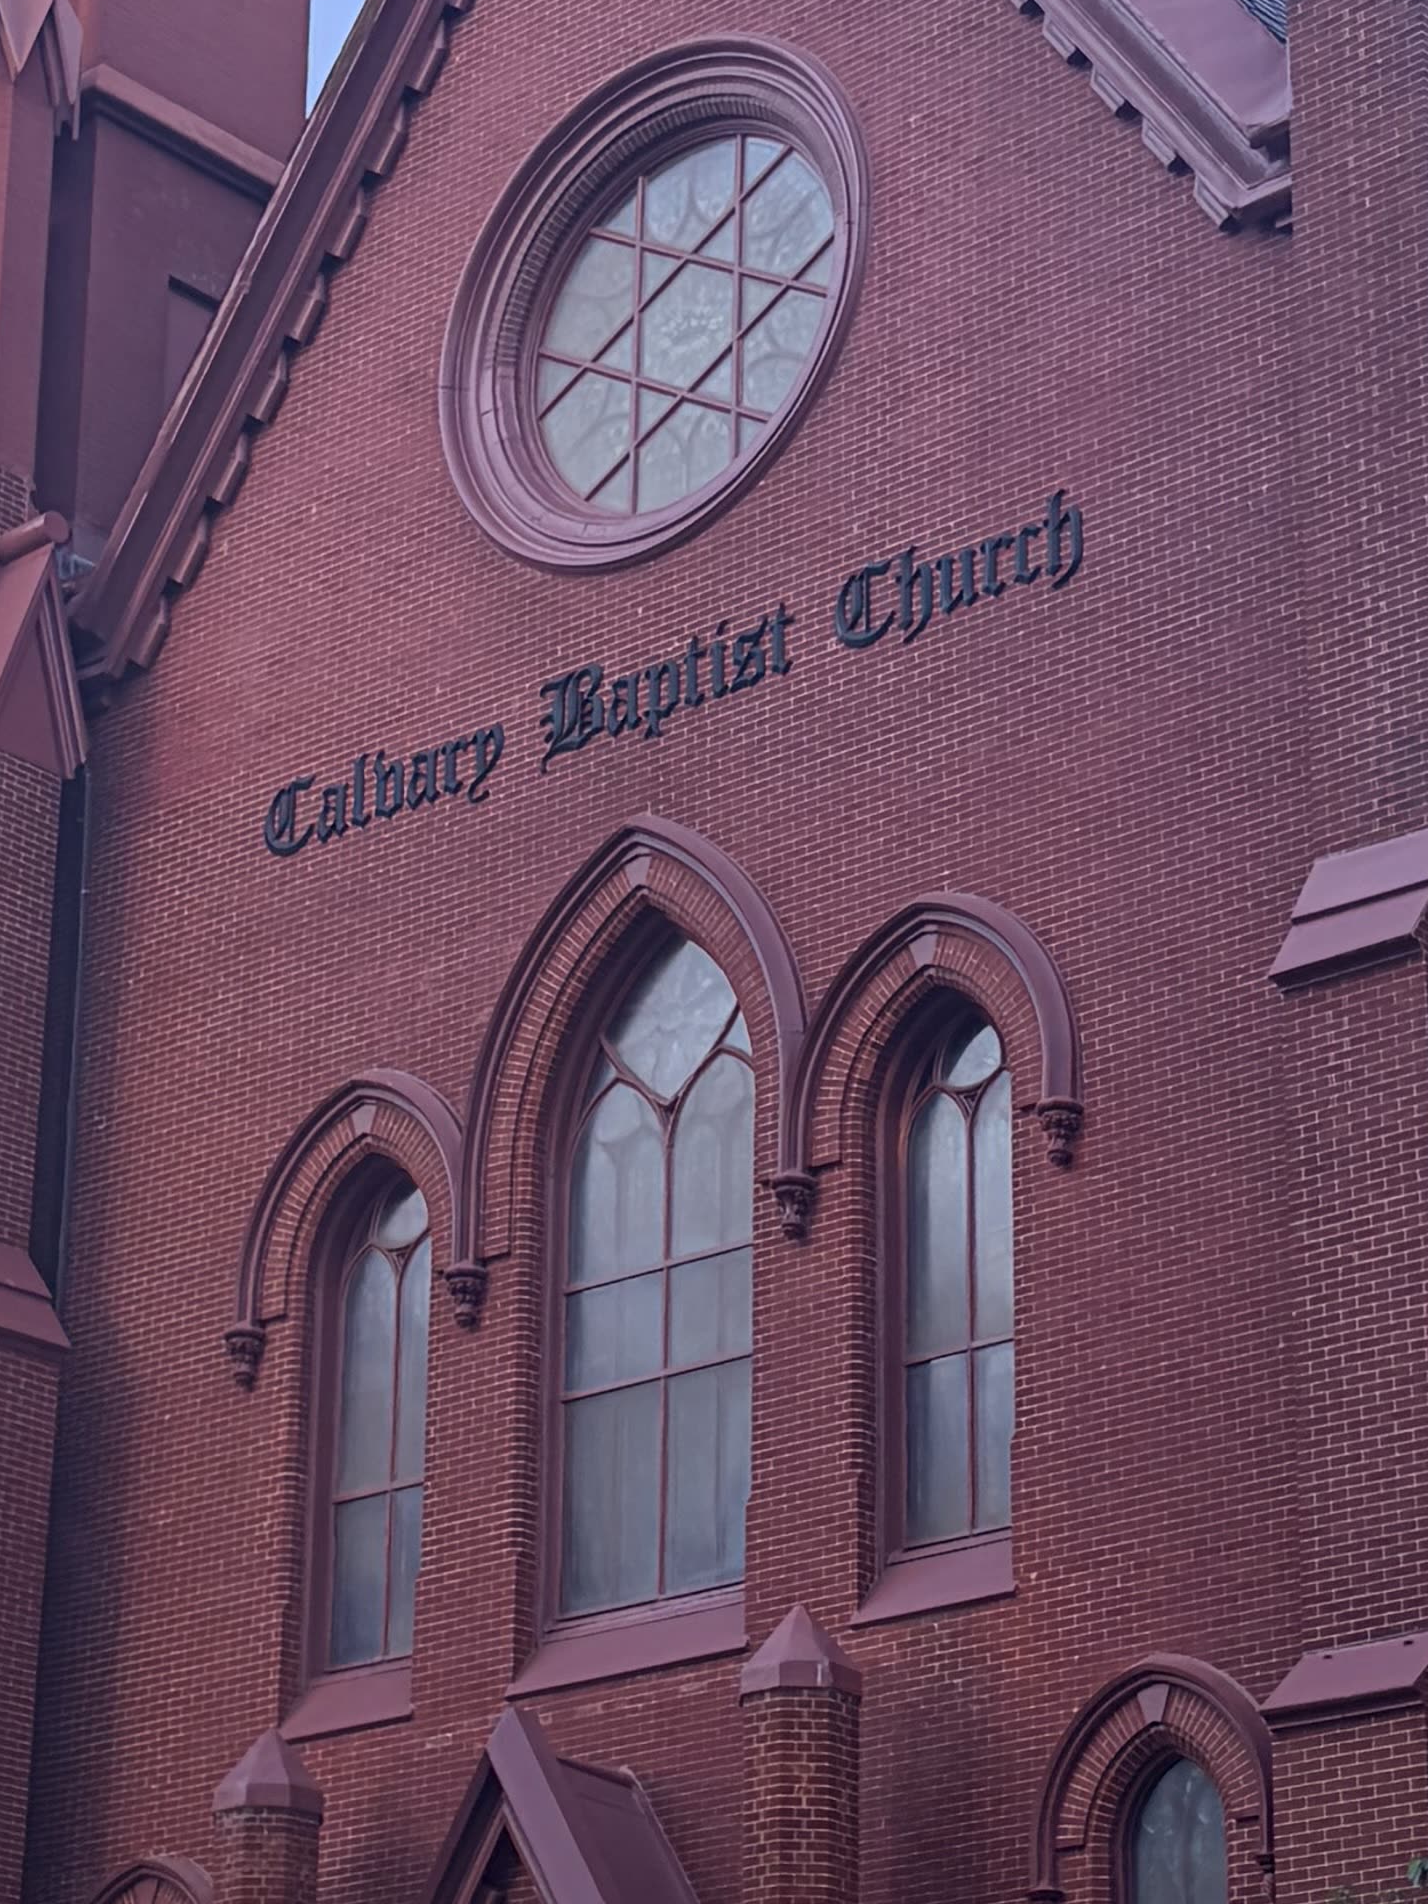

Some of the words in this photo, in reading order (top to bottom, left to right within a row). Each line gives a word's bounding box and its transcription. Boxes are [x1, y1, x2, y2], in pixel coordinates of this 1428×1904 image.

[264, 722, 505, 857] Calvary
[539, 603, 796, 775] Baptist
[835, 488, 1085, 650] Church
